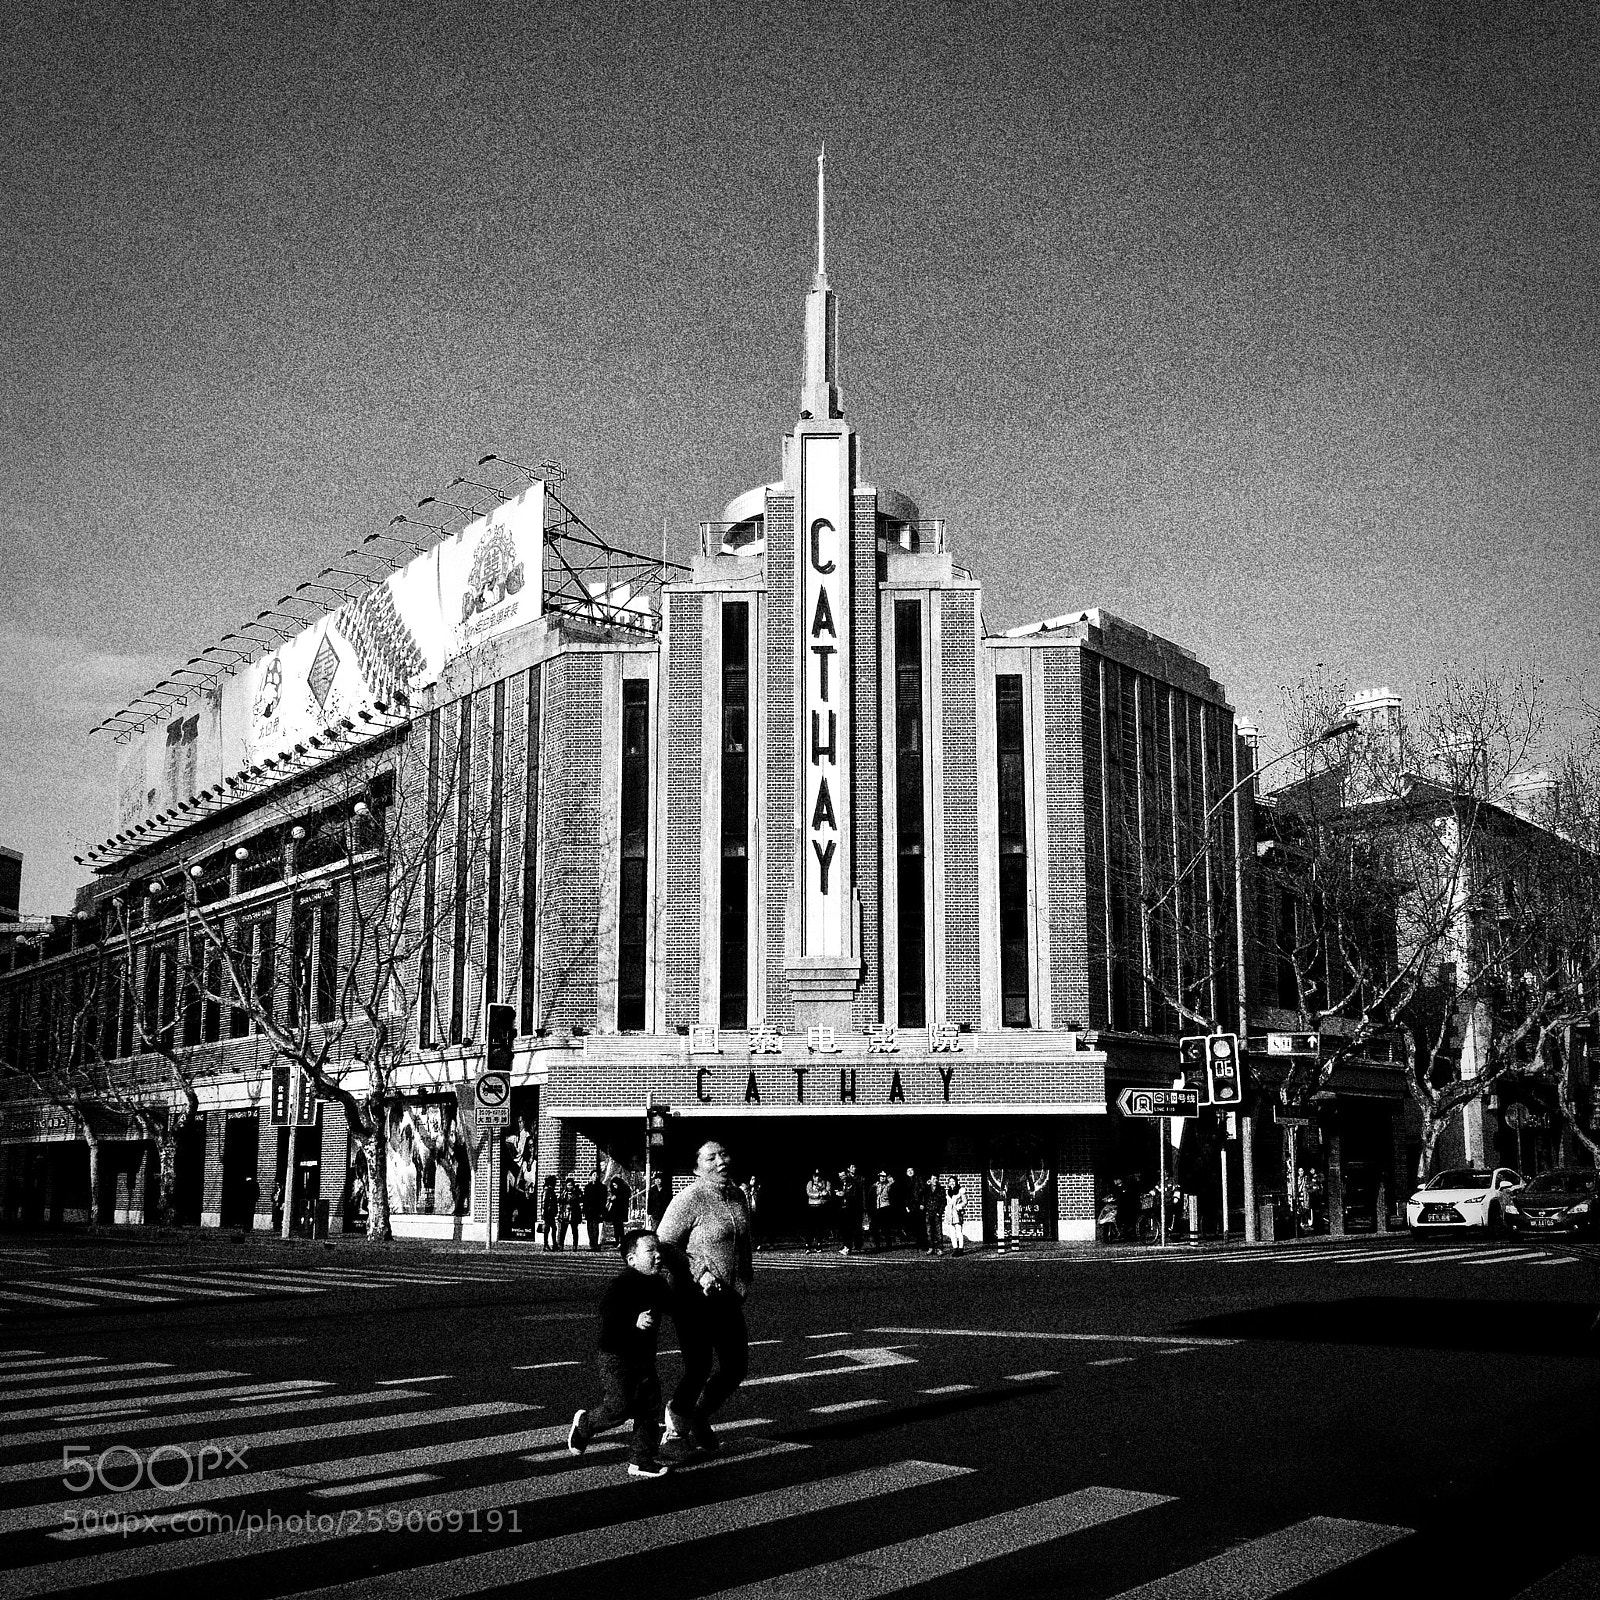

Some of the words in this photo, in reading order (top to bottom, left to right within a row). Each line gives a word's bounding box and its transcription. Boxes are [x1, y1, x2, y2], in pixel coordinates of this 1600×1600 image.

[810, 517, 838, 896] CATHAY
[689, 1022, 962, 1054] 国泰电影院
[696, 1067, 954, 1104] CATHAY
[1214, 1060, 1234, 1078] 06
